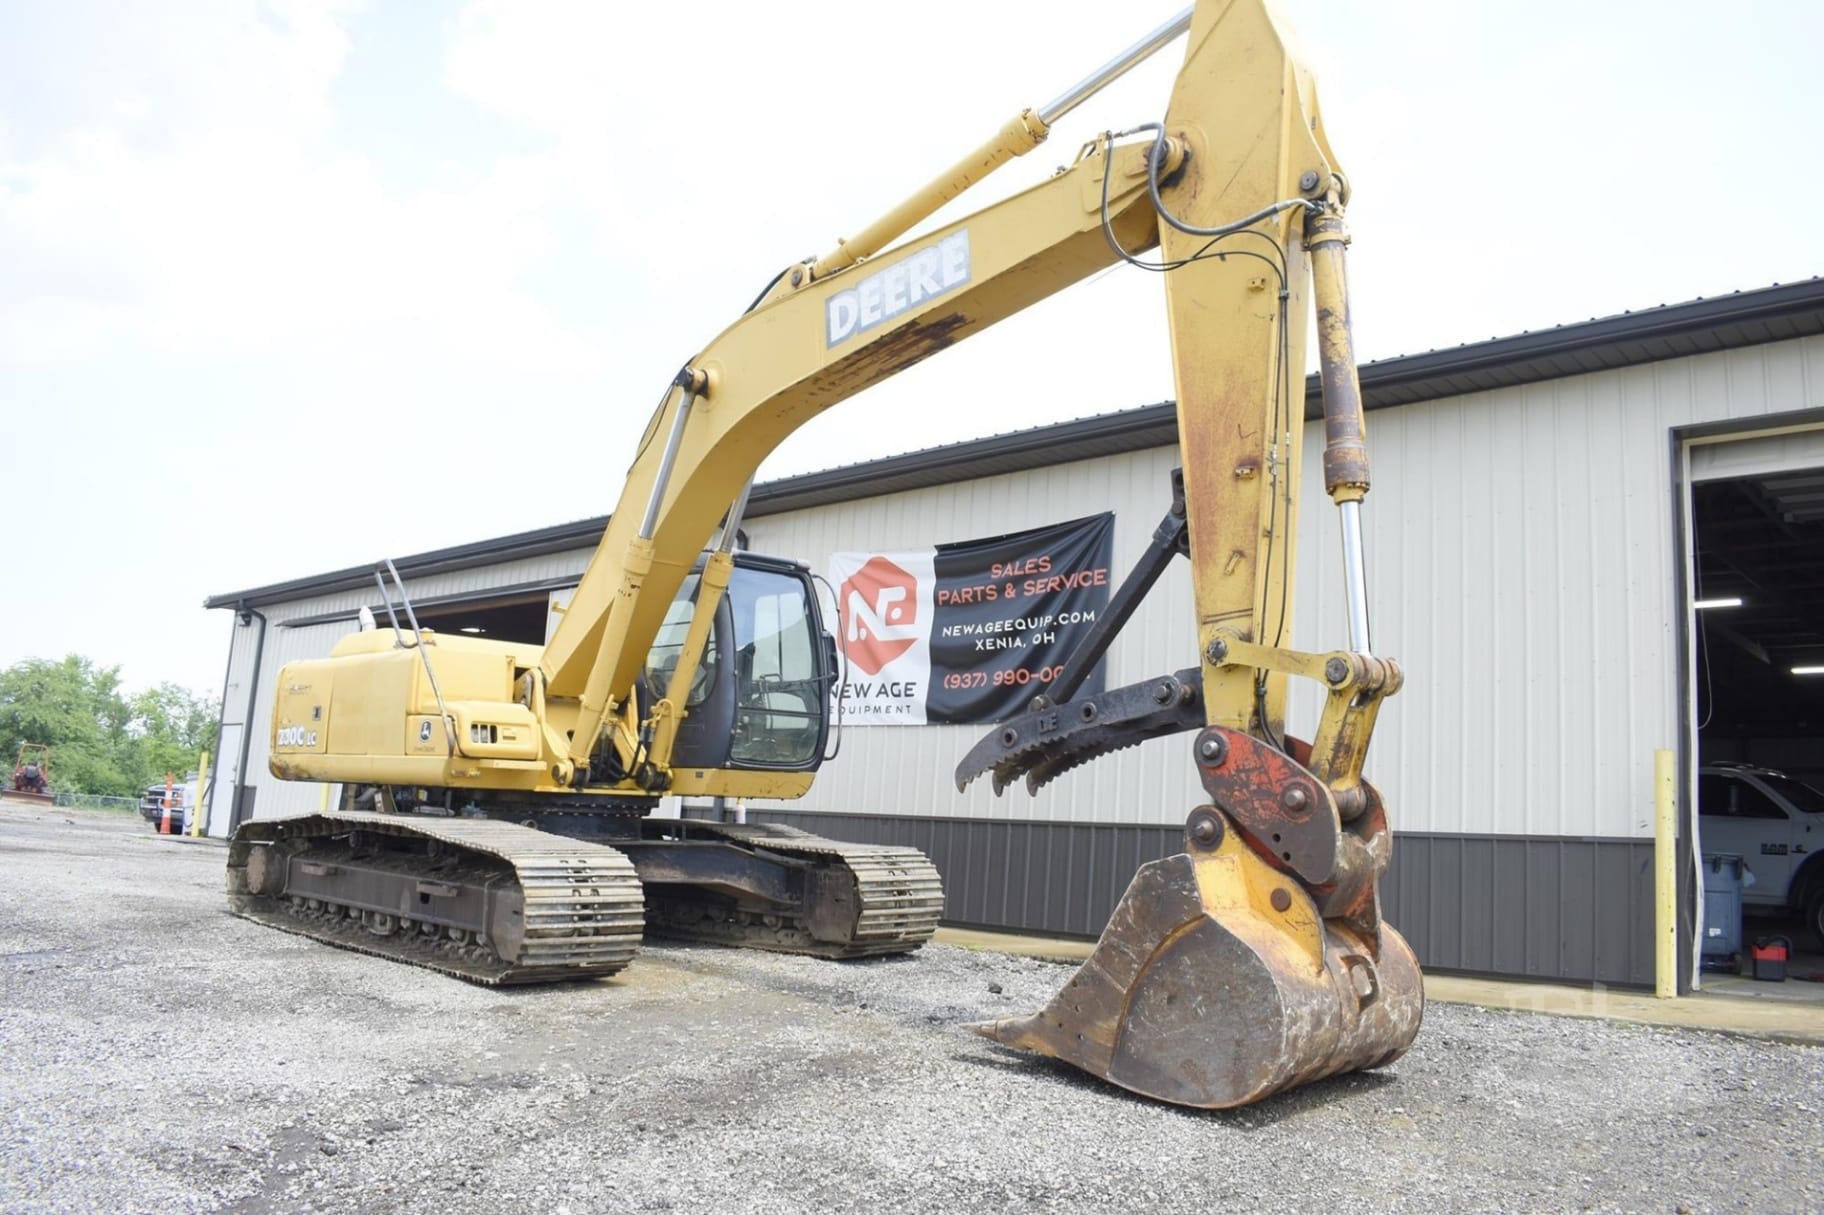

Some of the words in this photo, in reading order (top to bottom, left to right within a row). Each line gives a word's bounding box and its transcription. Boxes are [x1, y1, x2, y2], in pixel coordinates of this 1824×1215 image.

[826, 227, 971, 347] DEERE
[990, 555, 1051, 579] SALES
[938, 584, 998, 606] PARTS
[1004, 583, 1016, 598] &
[1023, 568, 1108, 597] SERVICE
[941, 610, 1095, 637] NEWAGEEQUIP.COM
[975, 635, 1026, 651] XENIA,
[1031, 632, 1055, 645] OH
[830, 682, 872, 699] NEW
[875, 681, 917, 699] AGE
[943, 671, 988, 689] (937)
